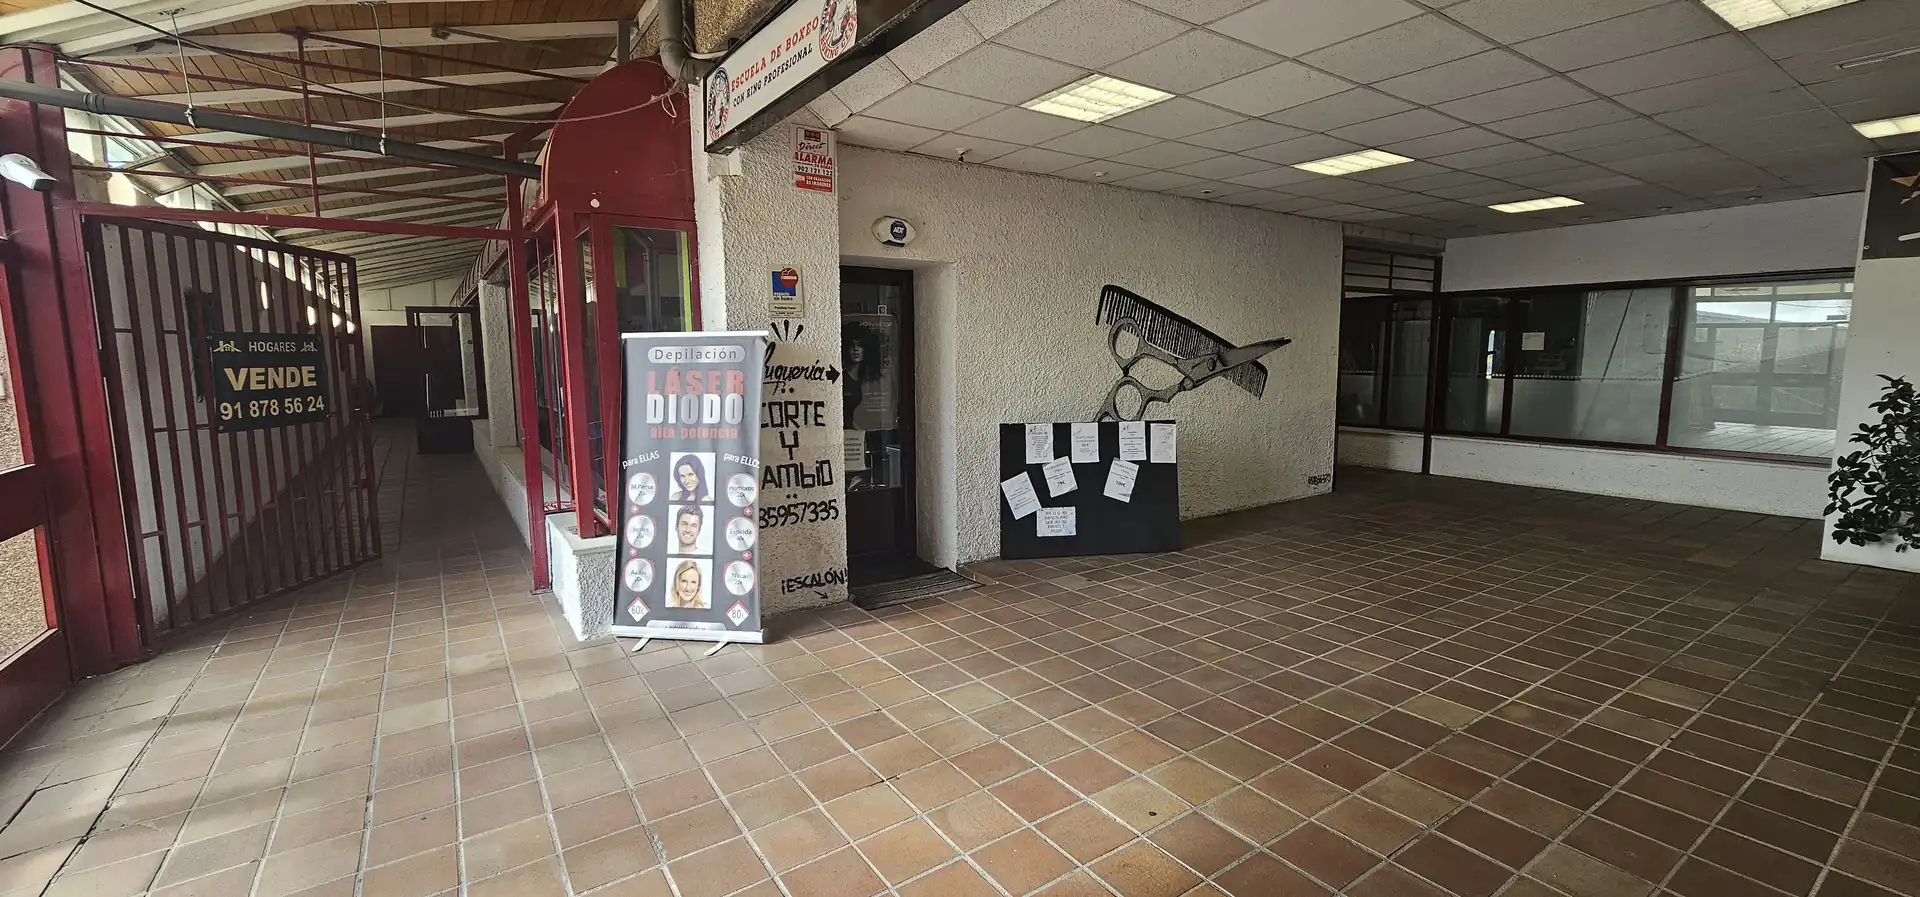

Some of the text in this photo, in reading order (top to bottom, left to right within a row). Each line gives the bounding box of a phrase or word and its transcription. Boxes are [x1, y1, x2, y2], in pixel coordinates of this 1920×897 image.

[731, 57, 767, 92] ESCUELA
[770, 44, 782, 63] DE
[785, 16, 819, 52] BOXEO
[733, 43, 813, 108] CON RING PROFESIONAL
[798, 141, 827, 151] Direct
[794, 151, 833, 166] ALARMA
[248, 341, 297, 352] HOGARES
[653, 347, 737, 363] Depilación
[223, 365, 318, 392] VENDE
[646, 366, 744, 395] LÁSER
[220, 395, 325, 421] 91 878 56 24
[645, 393, 745, 425] DIODO
[650, 426, 739, 439] alta potencia
[723, 452, 740, 463] para
[778, 431, 800, 462] Y
[622, 450, 660, 470] para ELLAS
